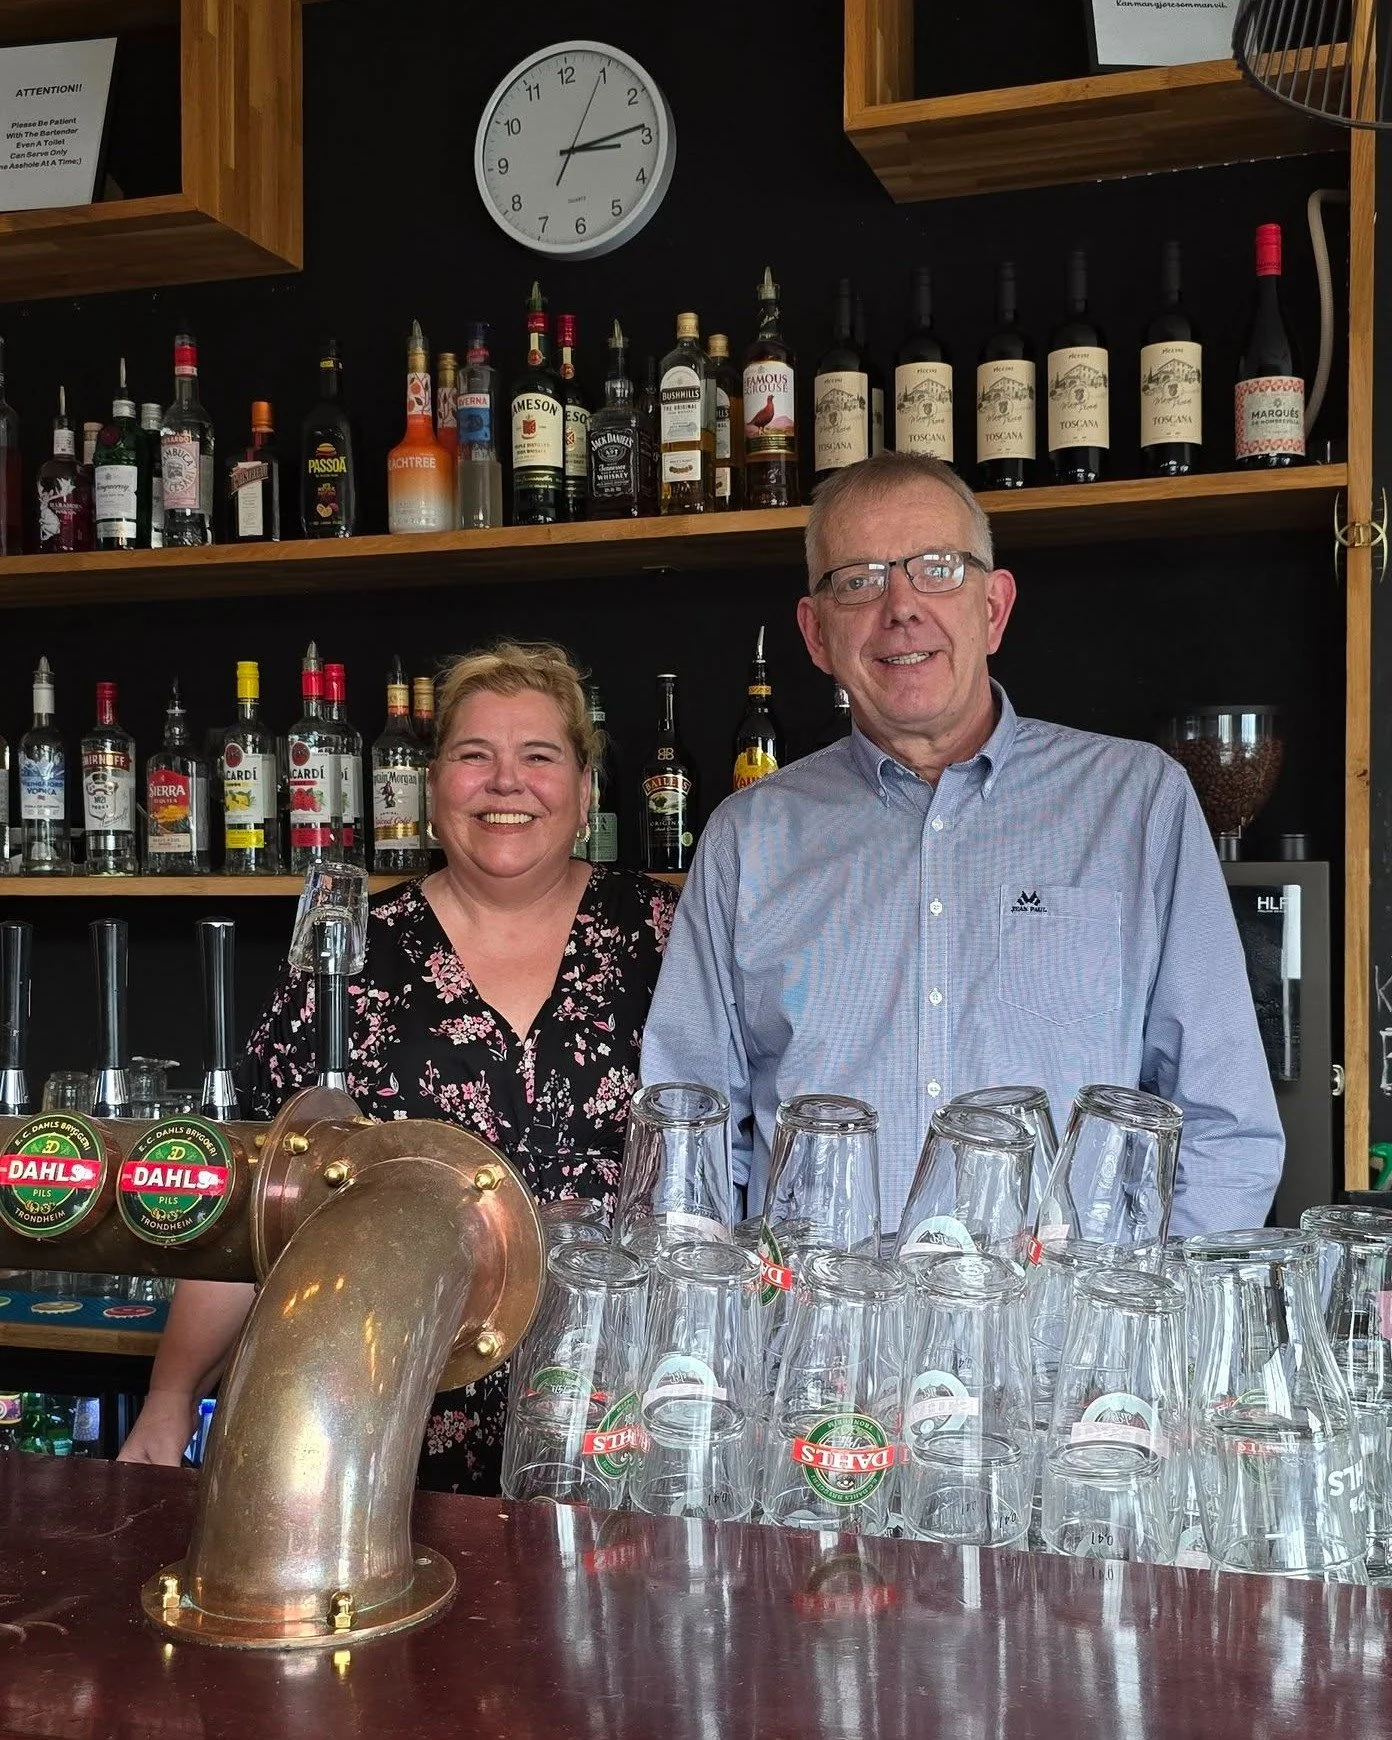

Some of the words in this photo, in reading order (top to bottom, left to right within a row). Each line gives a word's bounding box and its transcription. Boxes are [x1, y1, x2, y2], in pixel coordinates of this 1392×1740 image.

[557, 66, 576, 84] 12
[600, 66, 607, 84] 1
[15, 83, 82, 97] ATTENTION!!
[525, 83, 541, 102] 11
[627, 87, 638, 106] 2
[11, 121, 37, 129] Please
[49, 117, 77, 126] Patient
[504, 117, 521, 136] 10
[6, 131, 23, 140] With
[40, 128, 79, 137] Bartender
[641, 126, 653, 145] 3
[16, 141, 35, 149] Even
[43, 138, 65, 147] Toilet
[10, 152, 25, 160] Can
[26, 150, 49, 158] Serve
[50, 148, 68, 157] Only
[9, 160, 39, 170] Asshole
[40, 159, 49, 167] At
[50, 158, 57, 166] A
[497, 157, 509, 175] 9
[635, 167, 648, 184] 4
[511, 194, 522, 212] 8
[611, 198, 622, 217] 5
[538, 215, 549, 234] 7
[574, 216, 587, 235] 6
[746, 373, 788, 387] FAMOUS
[662, 389, 700, 401] BUSHMILLS
[1152, 414, 1193, 426] TOSCANA
[1251, 406, 1299, 420] MARQUÉS
[1059, 419, 1099, 430] TOSCANA
[591, 435, 607, 451] JACK
[909, 432, 946, 443] TOSCANA
[984, 431, 1024, 442] TOSCANA
[817, 441, 852, 453] TOSCANA
[162, 447, 194, 467] AMBUCA
[225, 765, 258, 780] CARDÍ
[149, 783, 187, 798] SIERRA
[645, 775, 690, 792] BAILES
[32, 1121, 60, 1133] DAHLS
[60, 1122, 91, 1151] BRYGGERI
[156, 1126, 184, 1138] DAHLS
[8, 1160, 86, 1182] DAHLS
[133, 1166, 212, 1189] DAHLS
[32, 1188, 51, 1198] PILS
[159, 1196, 178, 1205] PILS
[14, 1208, 66, 1223] TRONDHEIM
[140, 1214, 193, 1231] TRONDHEIM
[801, 1443, 890, 1470] DAHLS
